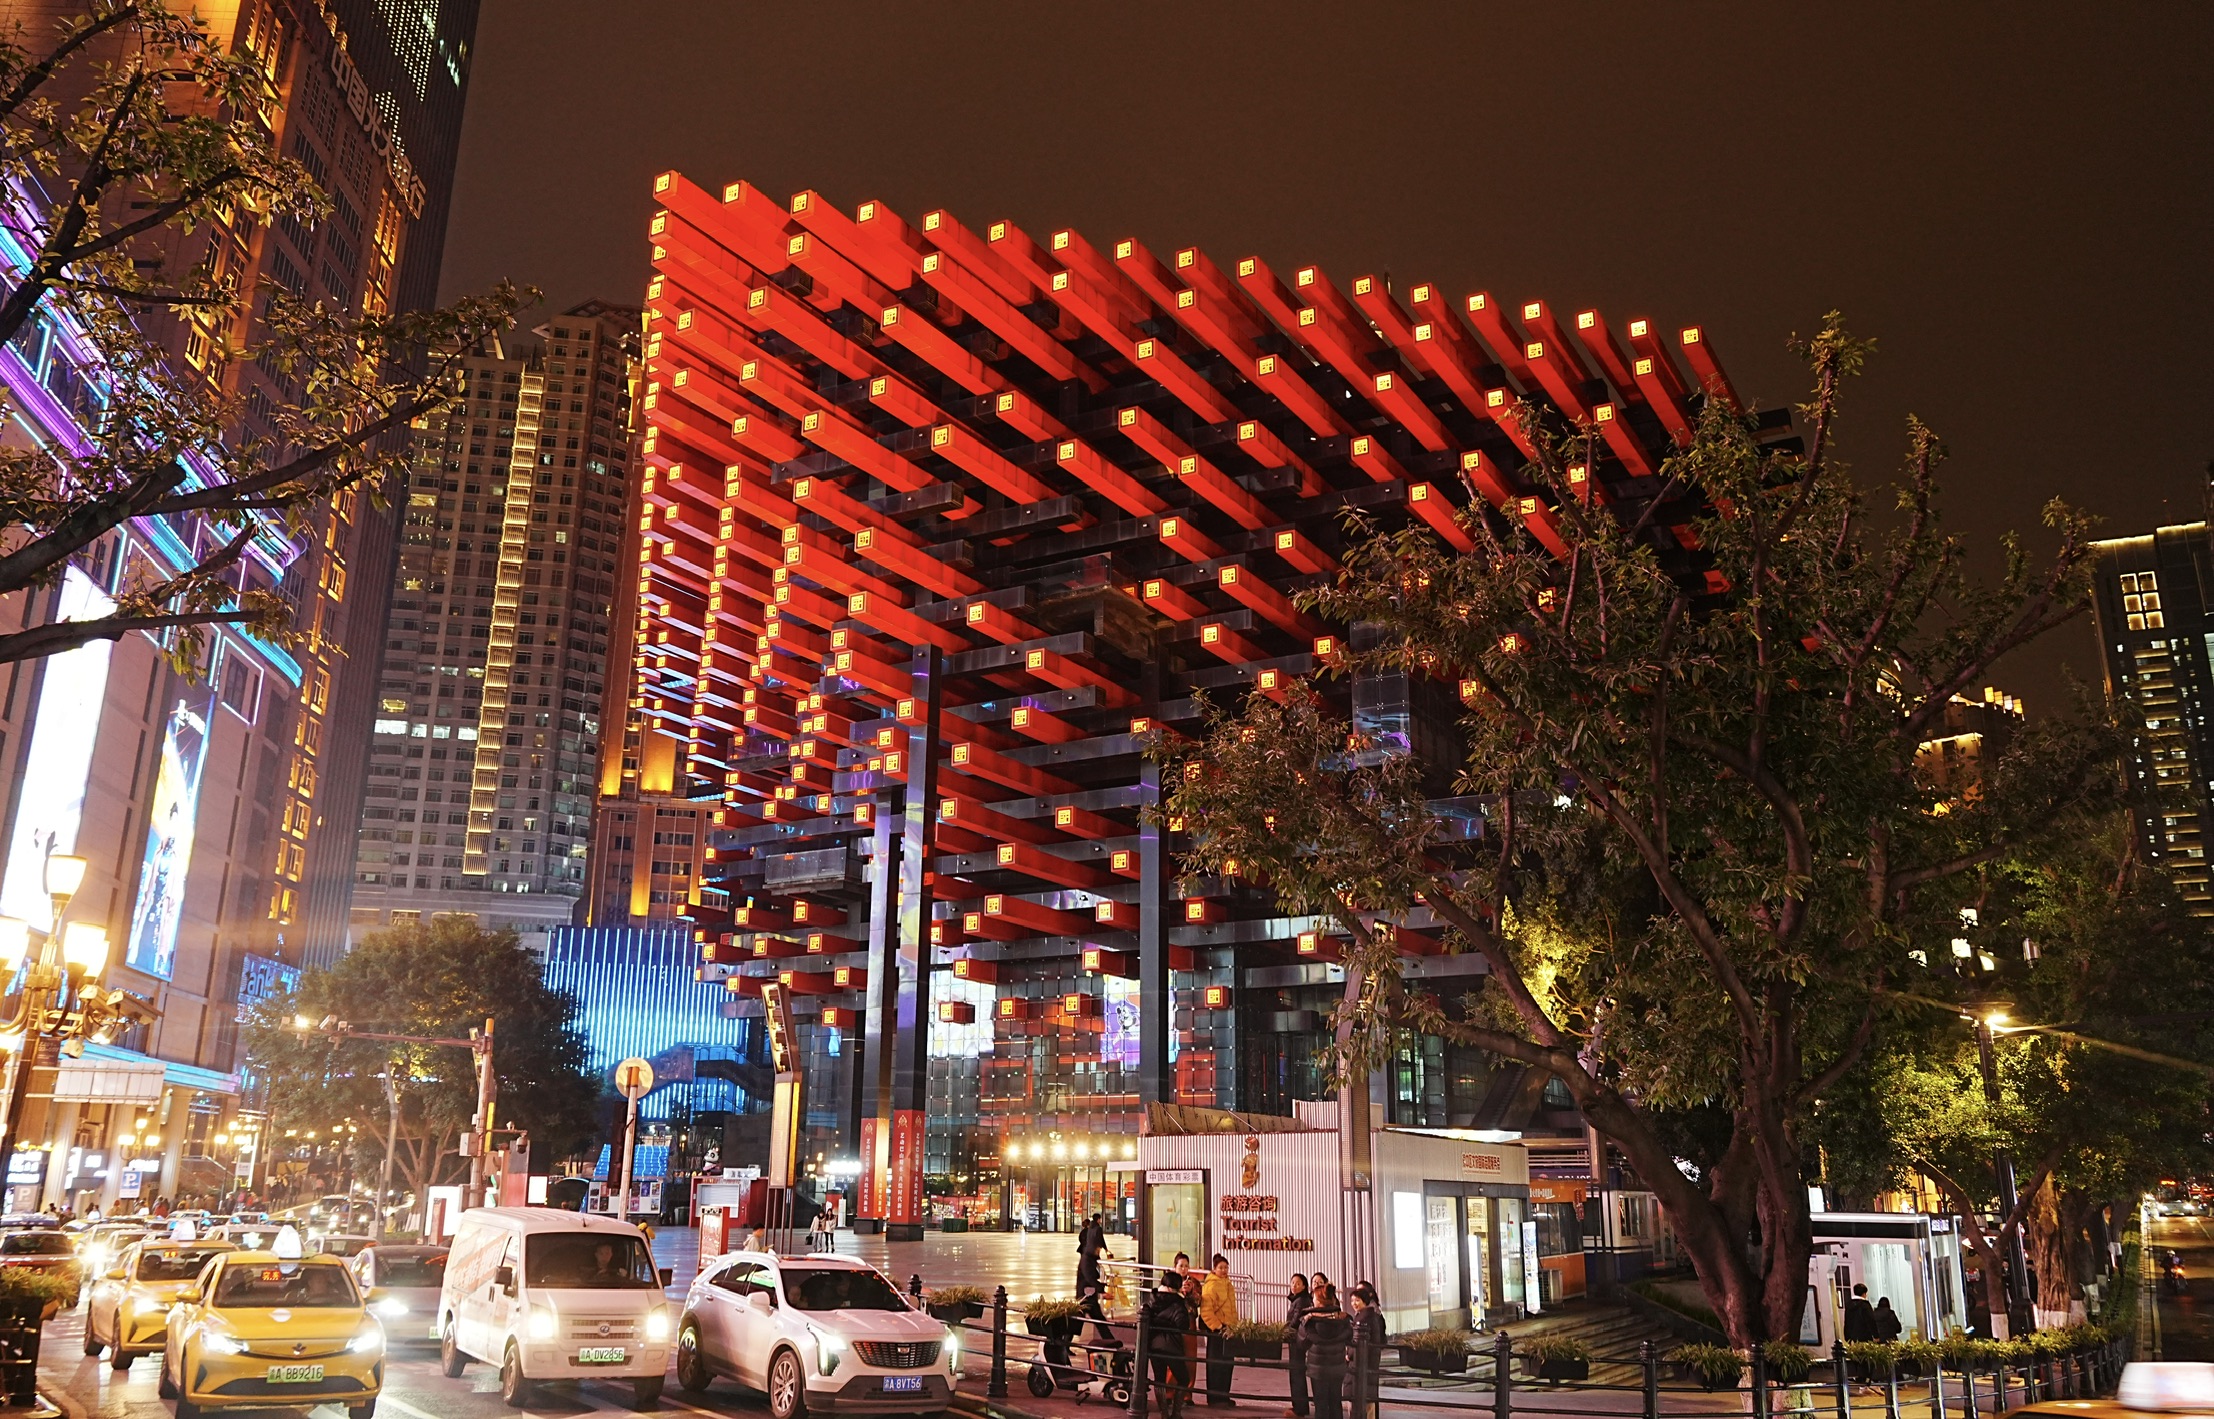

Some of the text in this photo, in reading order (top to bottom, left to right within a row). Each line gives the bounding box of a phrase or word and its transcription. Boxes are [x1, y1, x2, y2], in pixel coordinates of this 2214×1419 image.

[1150, 1172, 1199, 1182] 中国体育彩票
[1220, 1194, 1278, 1212] 旅游咨询
[1220, 1215, 1278, 1231] Tourist
[1221, 1234, 1313, 1251] Information
